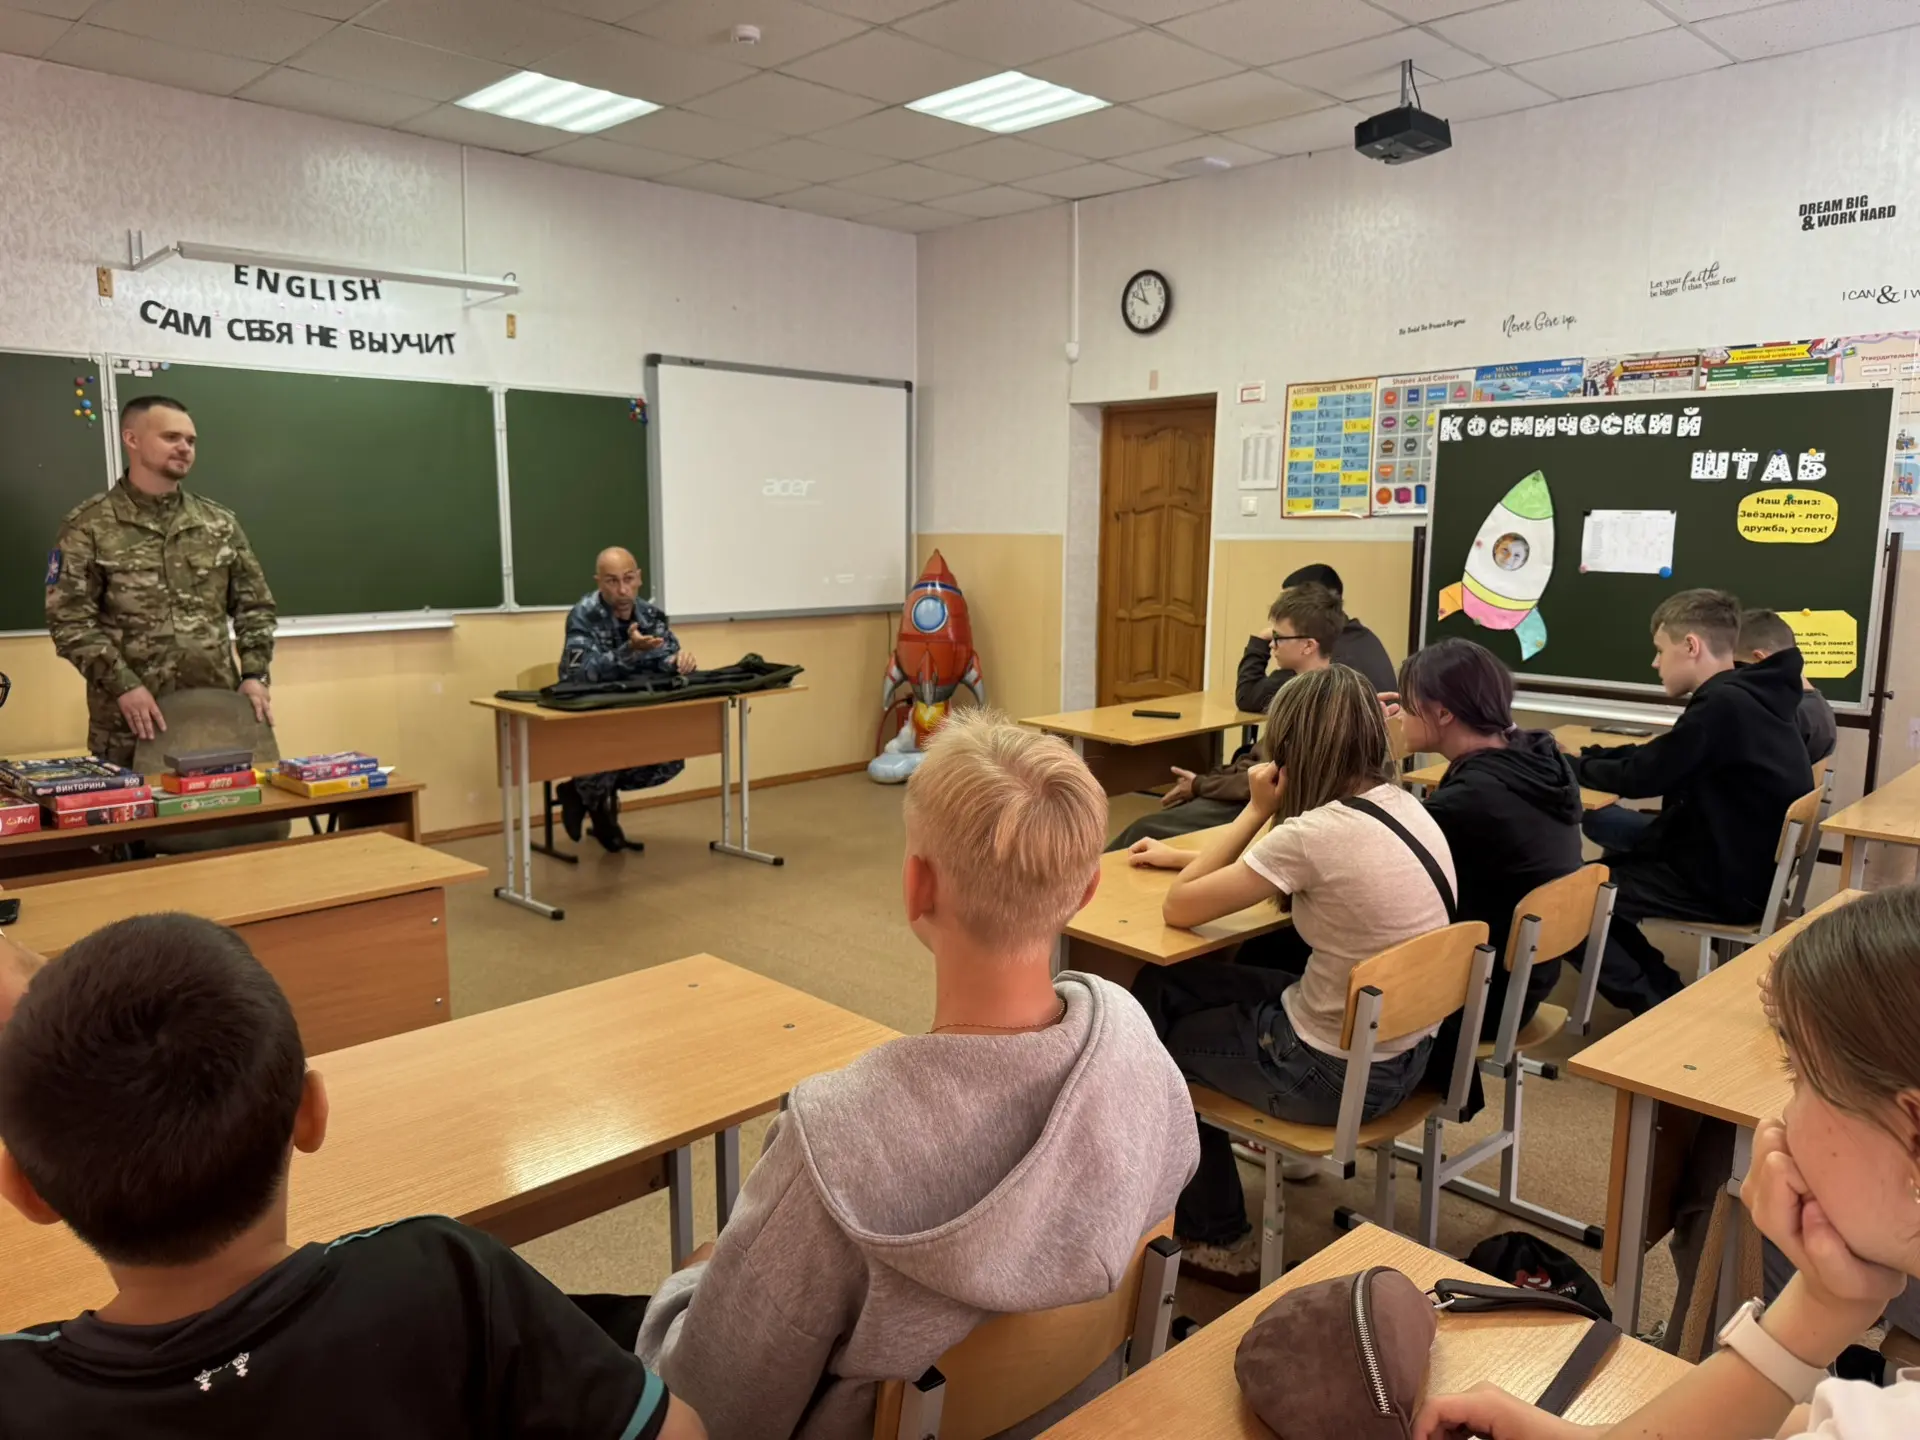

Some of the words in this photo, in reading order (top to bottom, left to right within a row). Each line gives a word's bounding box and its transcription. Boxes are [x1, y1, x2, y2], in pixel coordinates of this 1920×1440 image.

[1799, 198, 1843, 216] DREAM
[1846, 195, 1868, 210] BIG
[1802, 215, 1815, 231] &
[1818, 210, 1857, 228] WORK
[1860, 205, 1896, 222] HARD
[235, 264, 381, 301] ENGLISH
[1650, 280, 1662, 289] Let
[1666, 277, 1681, 288] your
[1682, 260, 1720, 291] faith
[1660, 286, 1678, 296] bigger
[1688, 282, 1702, 291] than
[1705, 278, 1720, 290] your
[1722, 276, 1736, 285] fear
[1842, 292, 1846, 301] I
[1848, 288, 1876, 300] CAN
[1876, 285, 1900, 304] &
[140, 300, 211, 338] САМ
[228, 318, 294, 344] СЕБЯ
[306, 324, 338, 349] НЕ
[349, 329, 456, 354] ВЫУЧИТ
[1691, 450, 1827, 482] ШТАБ
[762, 478, 816, 497] acer
[1756, 497, 1780, 505] Наш
[1784, 496, 1821, 506] девиз:
[1740, 510, 1795, 520] Звёздный
[1805, 512, 1834, 520] лето,
[1743, 524, 1788, 534] дружба,
[1792, 526, 1828, 534] успех!
[570, 648, 584, 667] Z
[56, 782, 106, 794] ВИКТОРИНА
